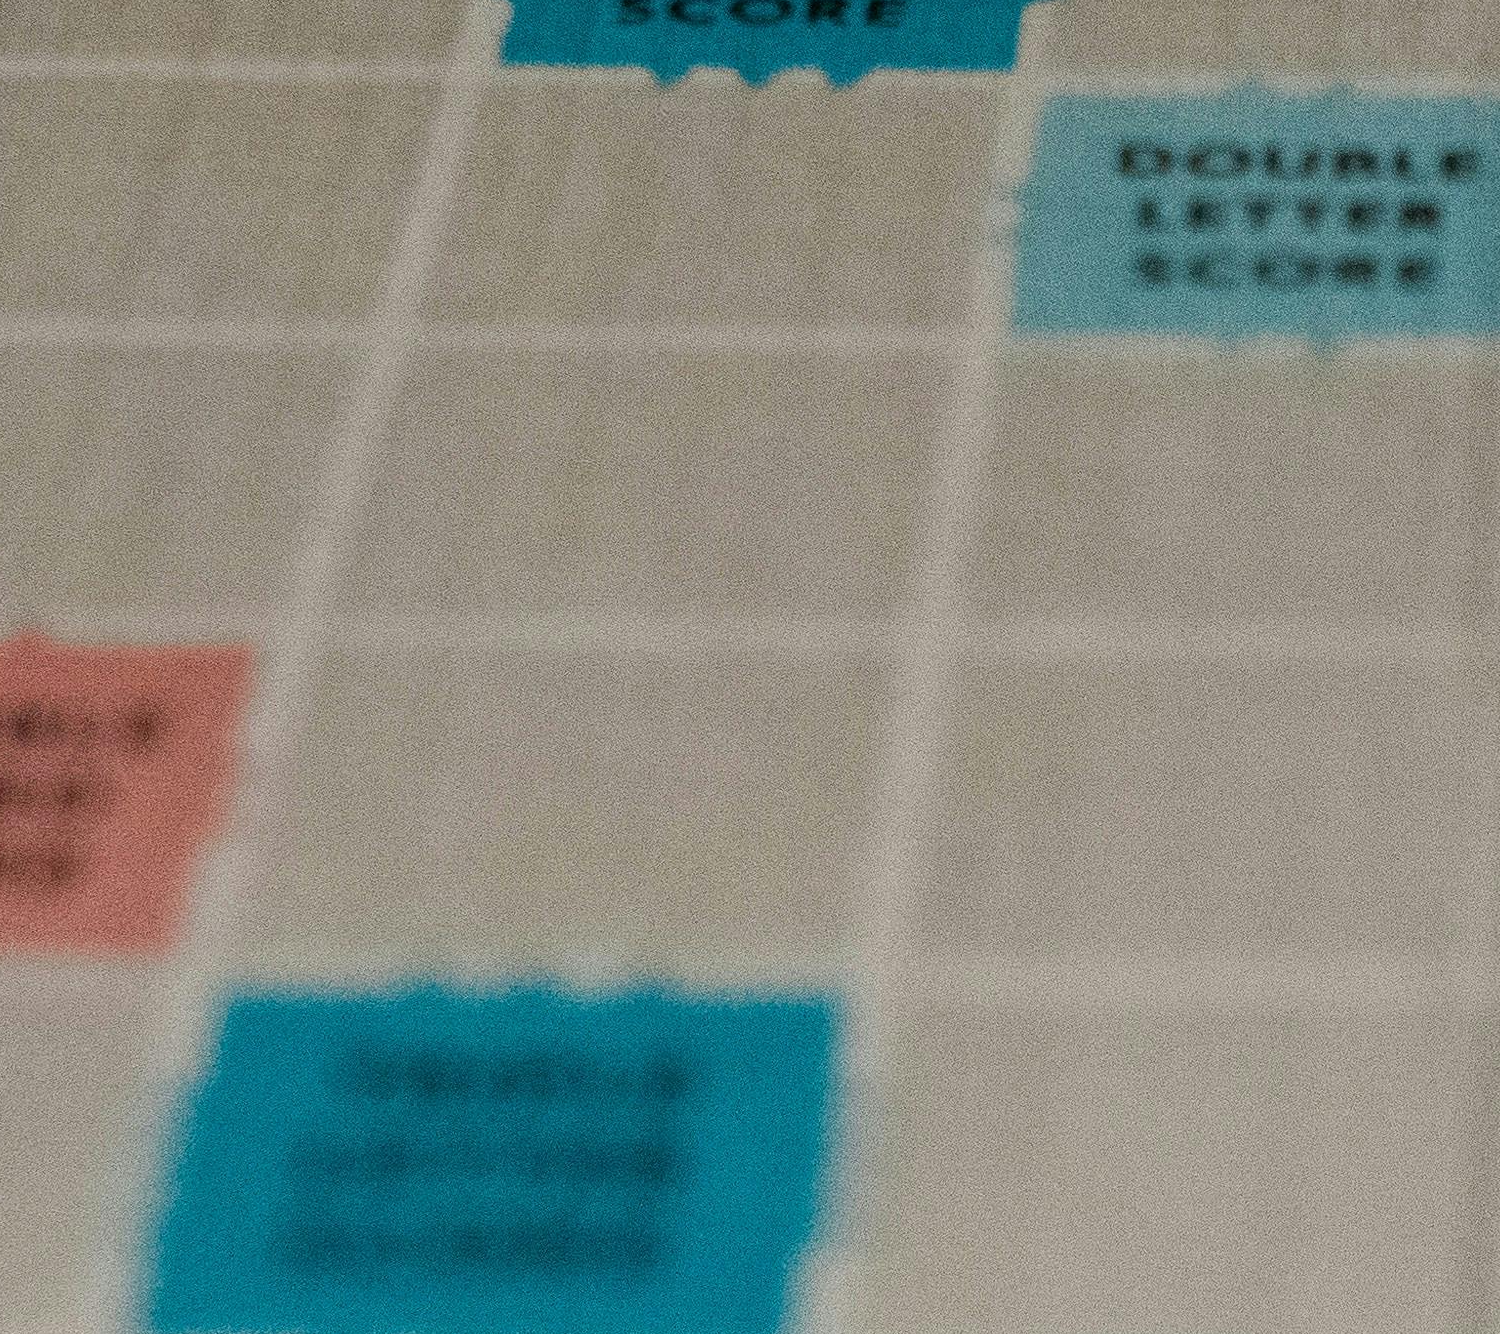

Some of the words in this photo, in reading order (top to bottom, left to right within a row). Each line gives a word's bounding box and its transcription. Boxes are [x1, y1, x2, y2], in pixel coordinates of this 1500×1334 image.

[1116, 141, 1480, 178] DOUBLE
[1136, 196, 1442, 231] LETTER
[1135, 252, 1438, 291] SCORE
